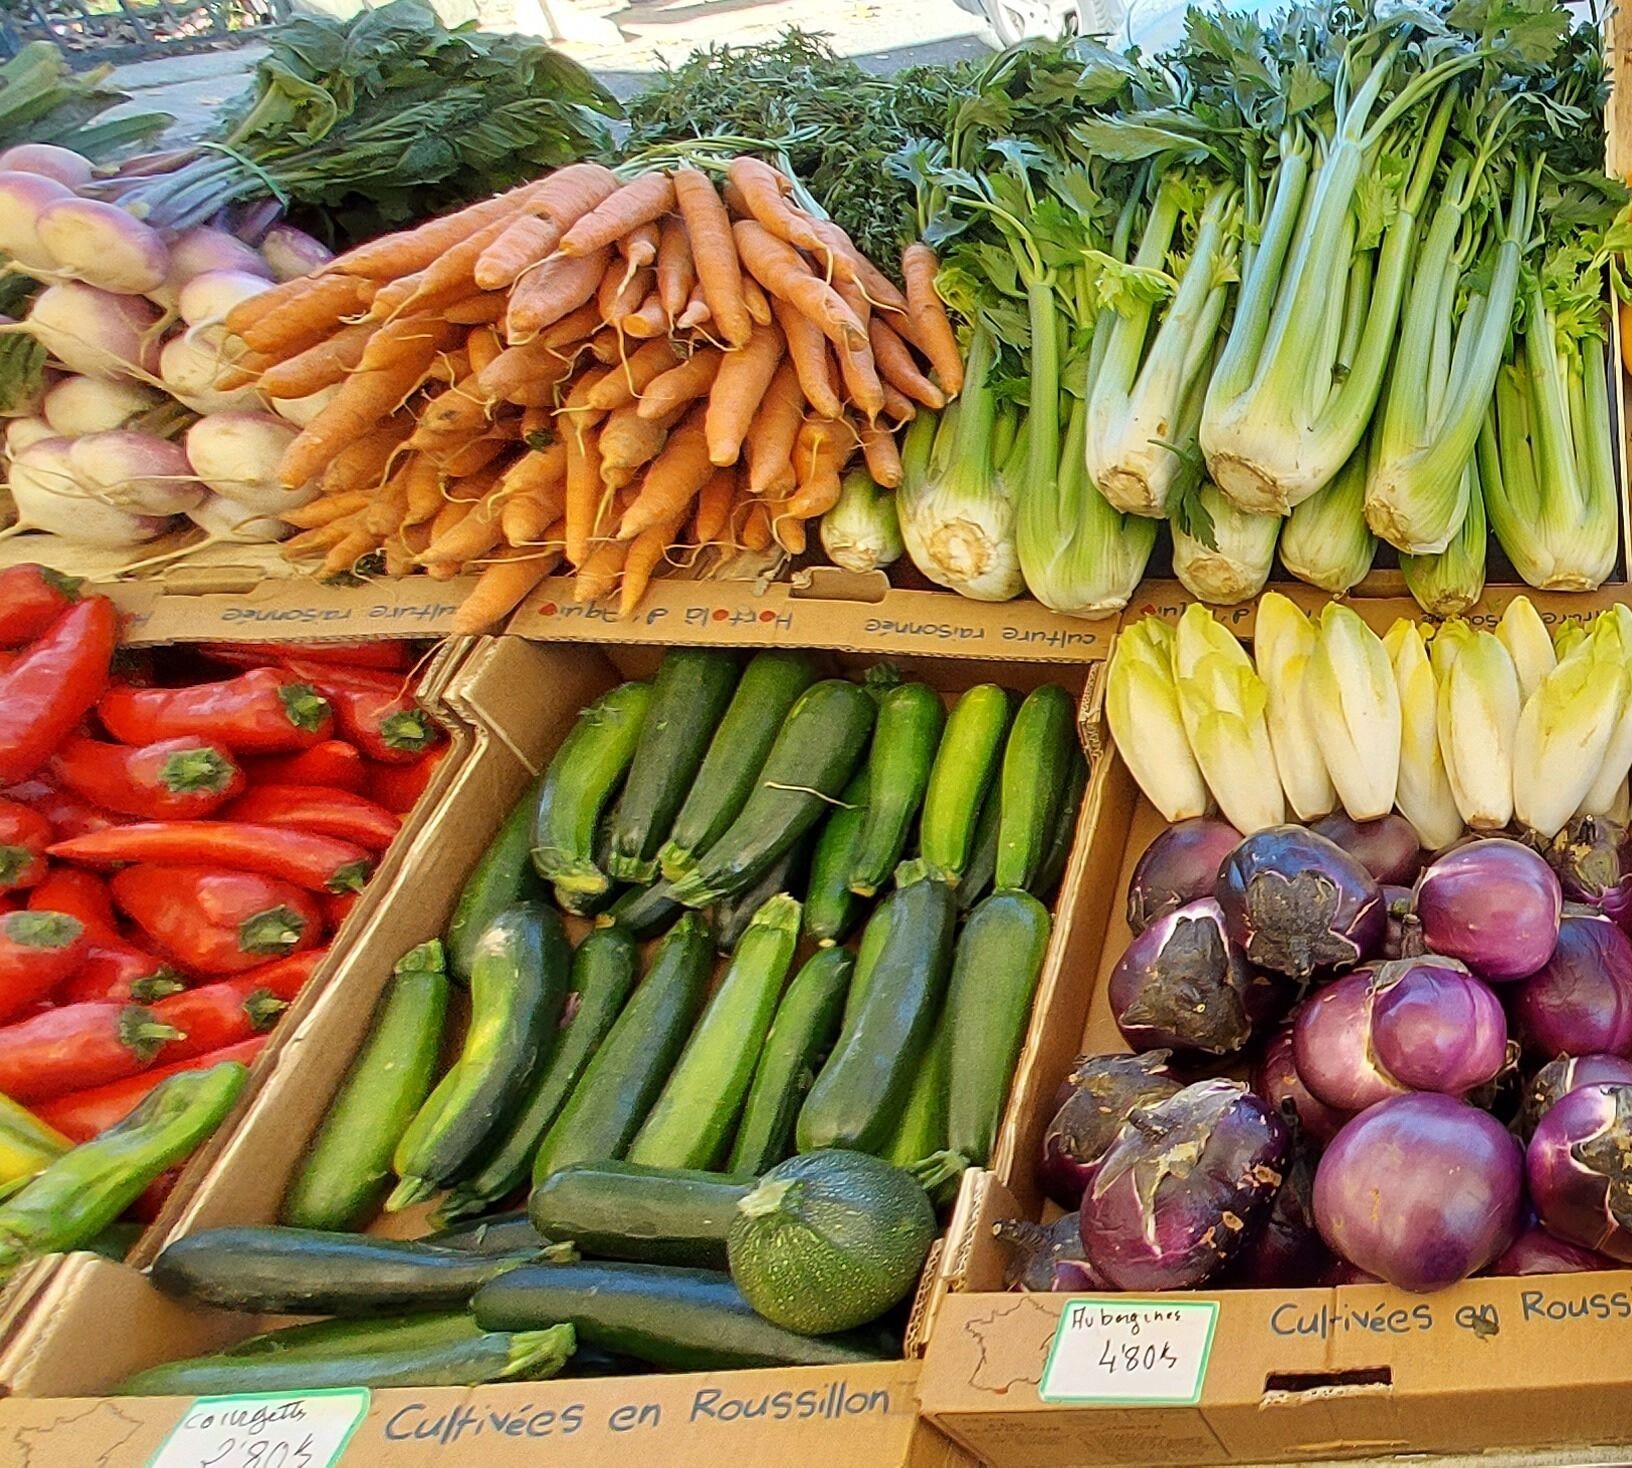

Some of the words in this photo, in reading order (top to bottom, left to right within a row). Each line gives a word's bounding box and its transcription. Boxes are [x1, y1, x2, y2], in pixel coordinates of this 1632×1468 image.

[369, 604, 456, 622] ulture
[864, 618, 985, 643] raisonnée
[1002, 626, 1098, 649] culture
[1270, 1303, 1434, 1339] Cultivées
[384, 1402, 585, 1445] Cultivées
[607, 1404, 663, 1433] en
[691, 1381, 891, 1422] Roussillon
